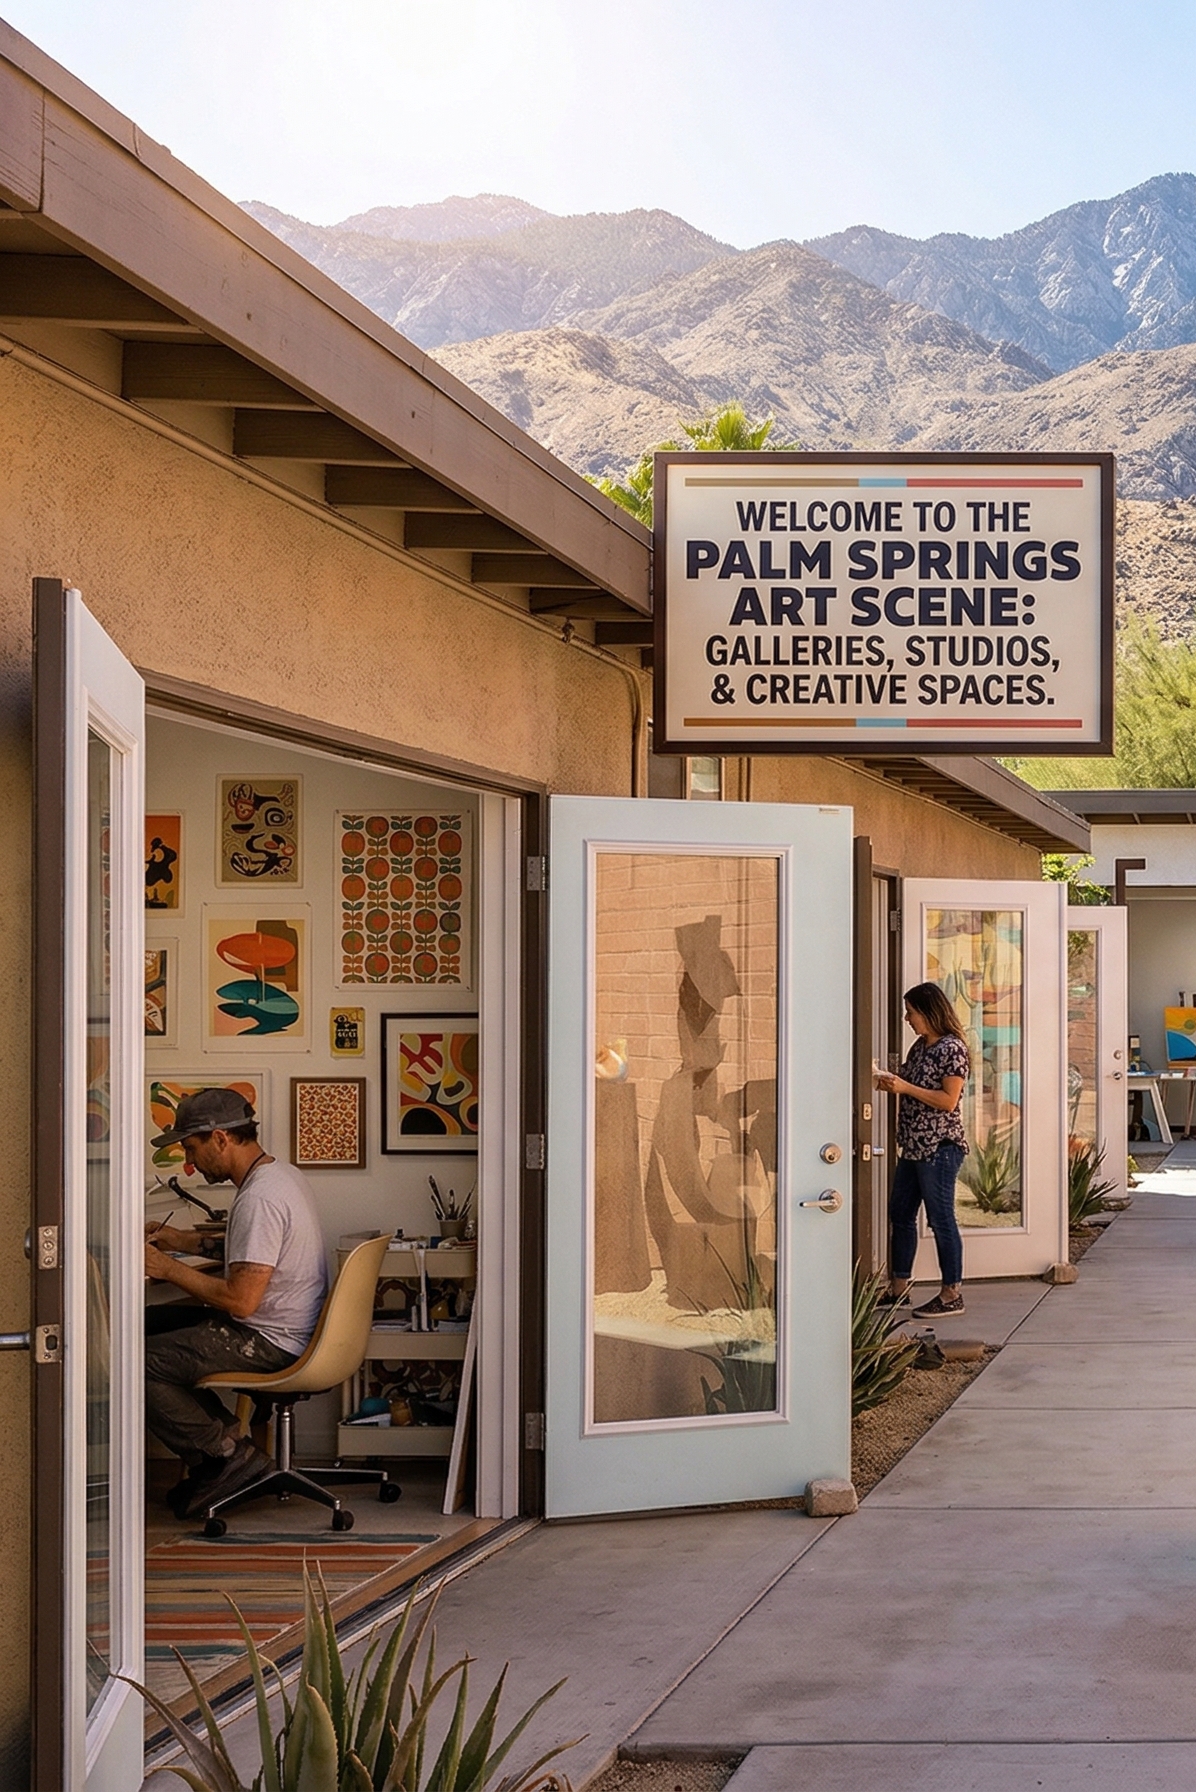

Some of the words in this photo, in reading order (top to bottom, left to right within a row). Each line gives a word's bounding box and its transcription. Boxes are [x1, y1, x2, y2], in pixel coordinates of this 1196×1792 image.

[735, 500, 903, 533] WELCOME
[912, 501, 956, 533] TO
[966, 501, 1031, 533] THE
[686, 540, 832, 580] PALM
[847, 539, 1082, 582] SPRINGS
[728, 586, 838, 627] ART
[850, 586, 1036, 627] SCENE:
[705, 634, 895, 673] GALLERIES,
[905, 635, 1060, 673] STUDIOS,
[710, 673, 736, 705] &
[746, 673, 907, 705] CREATIVE
[917, 673, 1055, 706] SPACES.
